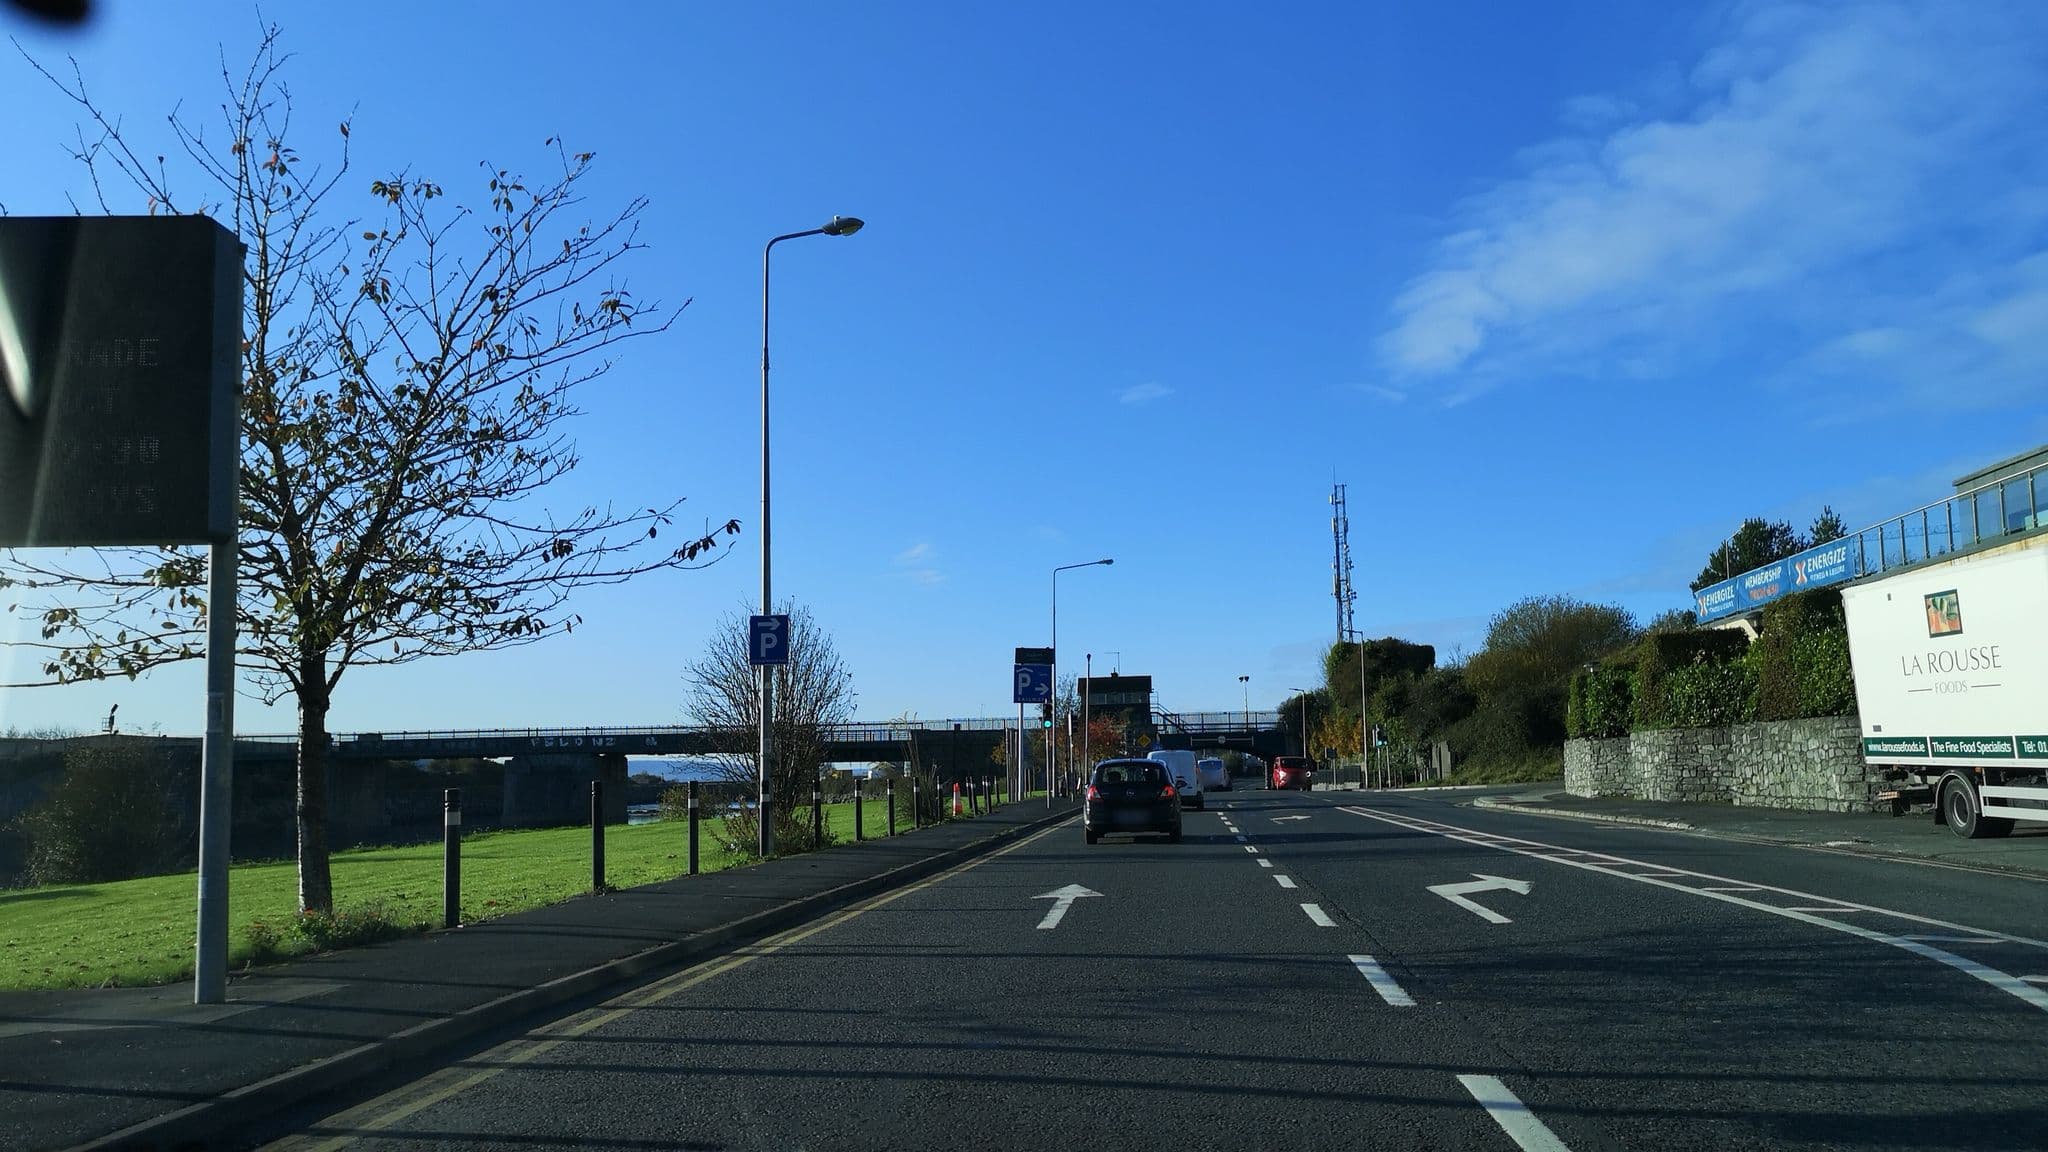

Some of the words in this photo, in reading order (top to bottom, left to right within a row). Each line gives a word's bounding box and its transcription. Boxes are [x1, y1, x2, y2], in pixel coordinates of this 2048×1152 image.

[1808, 546, 1847, 573] ENERGIZE
[1706, 585, 1735, 606] ENERGIZE
[760, 632, 778, 658] P
[1901, 655, 1923, 677] LA
[1927, 645, 2002, 675] ROUSSE
[1018, 672, 1032, 696] P
[1935, 680, 1968, 694] FOODS
[1867, 740, 1926, 753] www.laroussefoods.ie
[1932, 741, 1945, 753] The
[1946, 741, 1959, 753] Fine
[1960, 741, 1976, 753] Food
[1976, 740, 2012, 756] Specialists
[2022, 740, 2036, 753] Tel:
